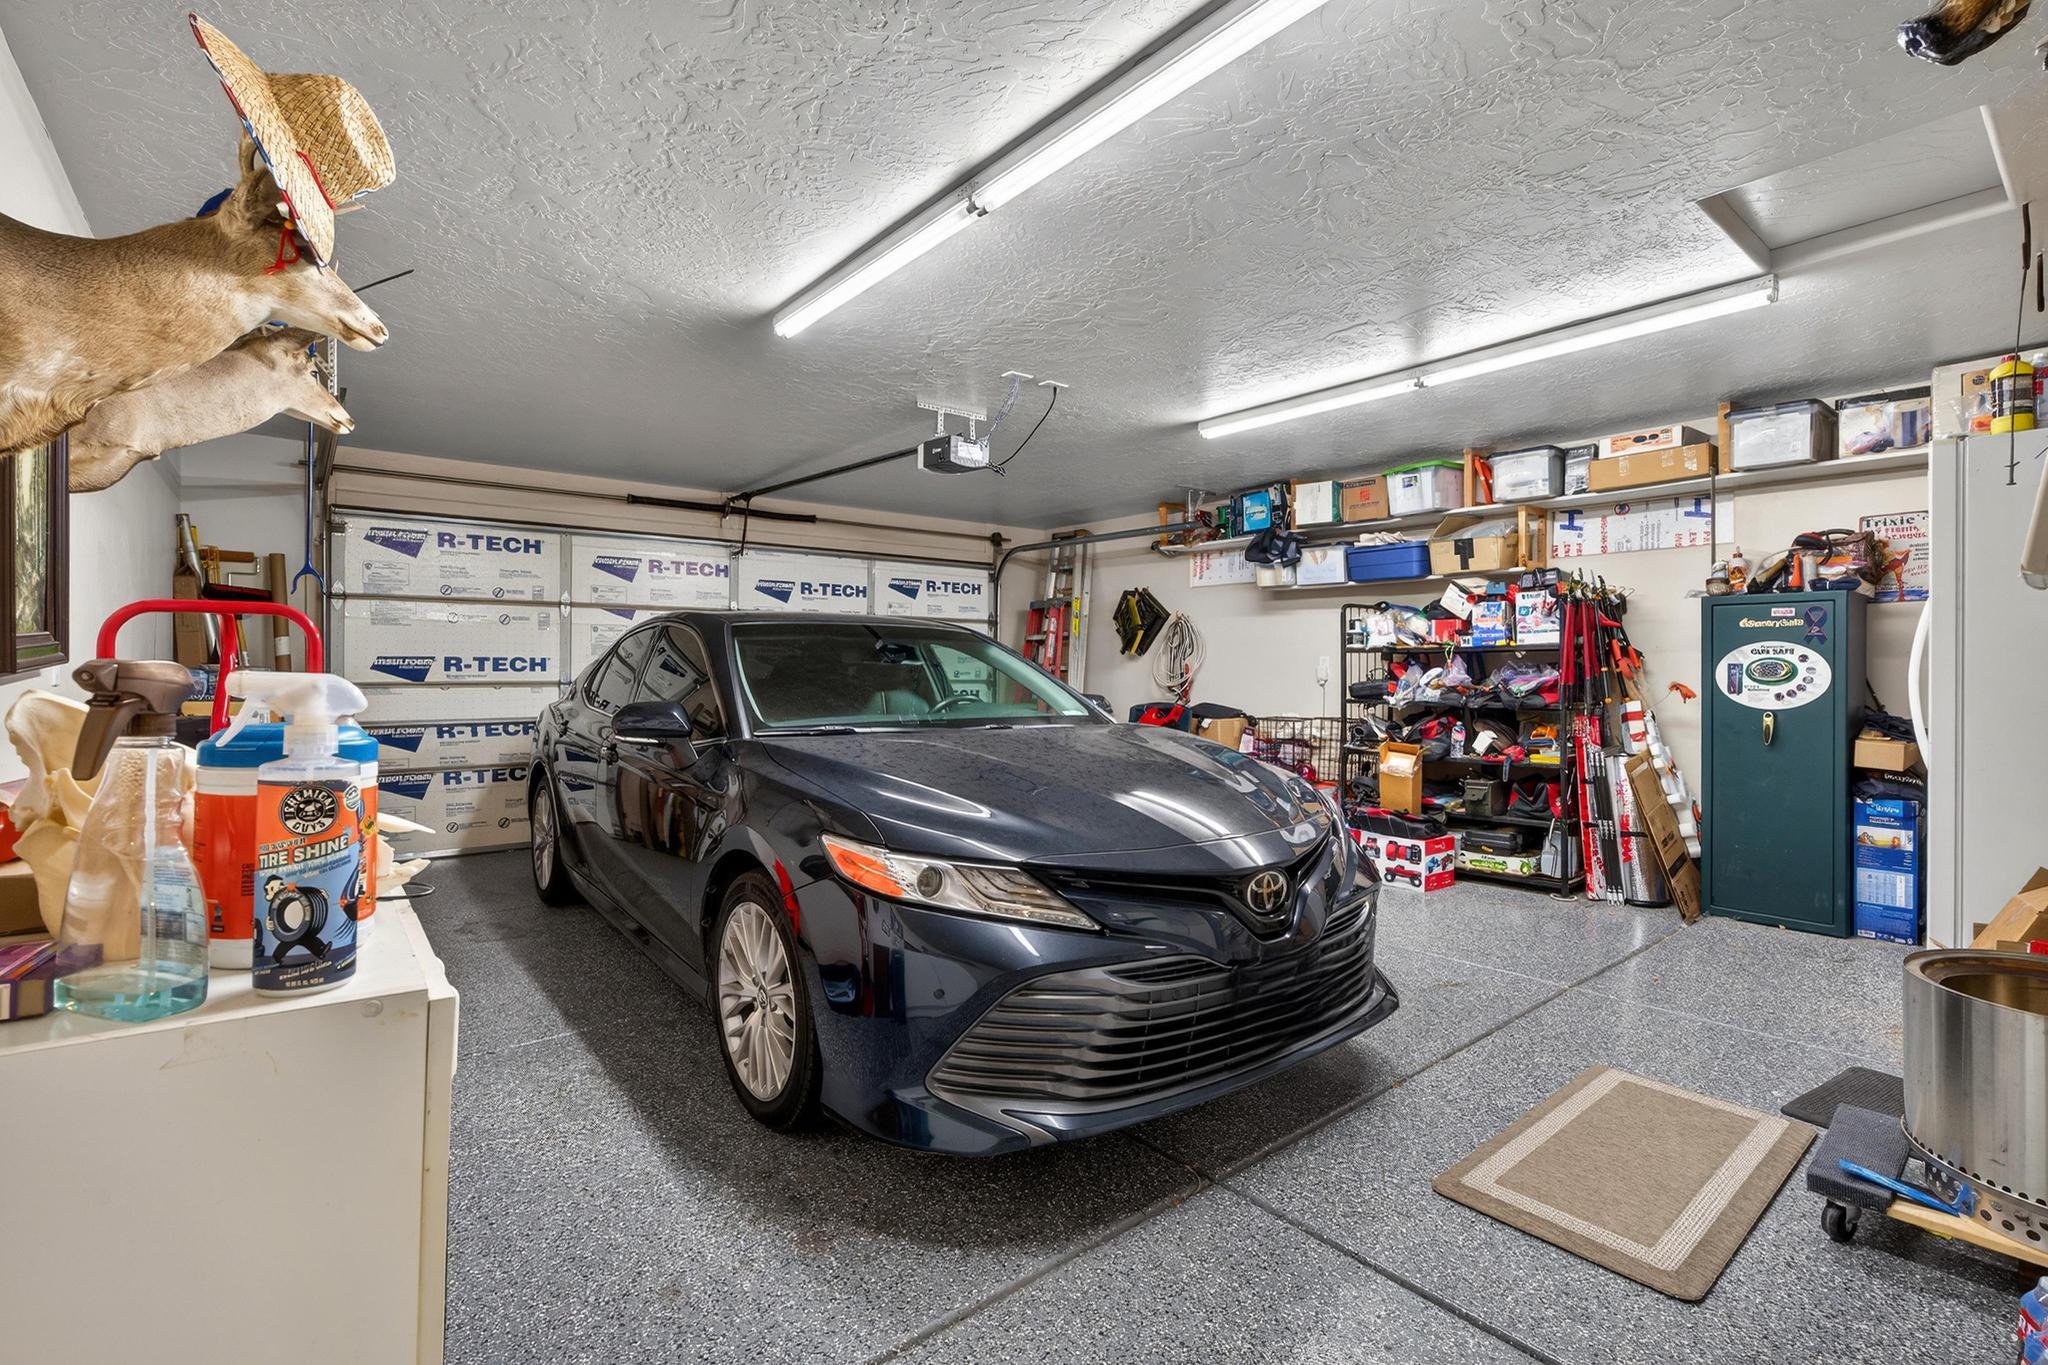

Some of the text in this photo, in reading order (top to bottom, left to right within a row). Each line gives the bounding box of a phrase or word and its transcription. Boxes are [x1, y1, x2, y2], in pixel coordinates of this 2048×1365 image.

[436, 532, 542, 555] R-TECH
[647, 559, 729, 578] R-TECH
[800, 581, 867, 598] R-TECH
[926, 579, 982, 595] R-TECH
[443, 656, 547, 673] R-TECH
[443, 767, 528, 786] R-TEC
[259, 850, 289, 869] TIRE
[293, 834, 350, 864] SHINE
